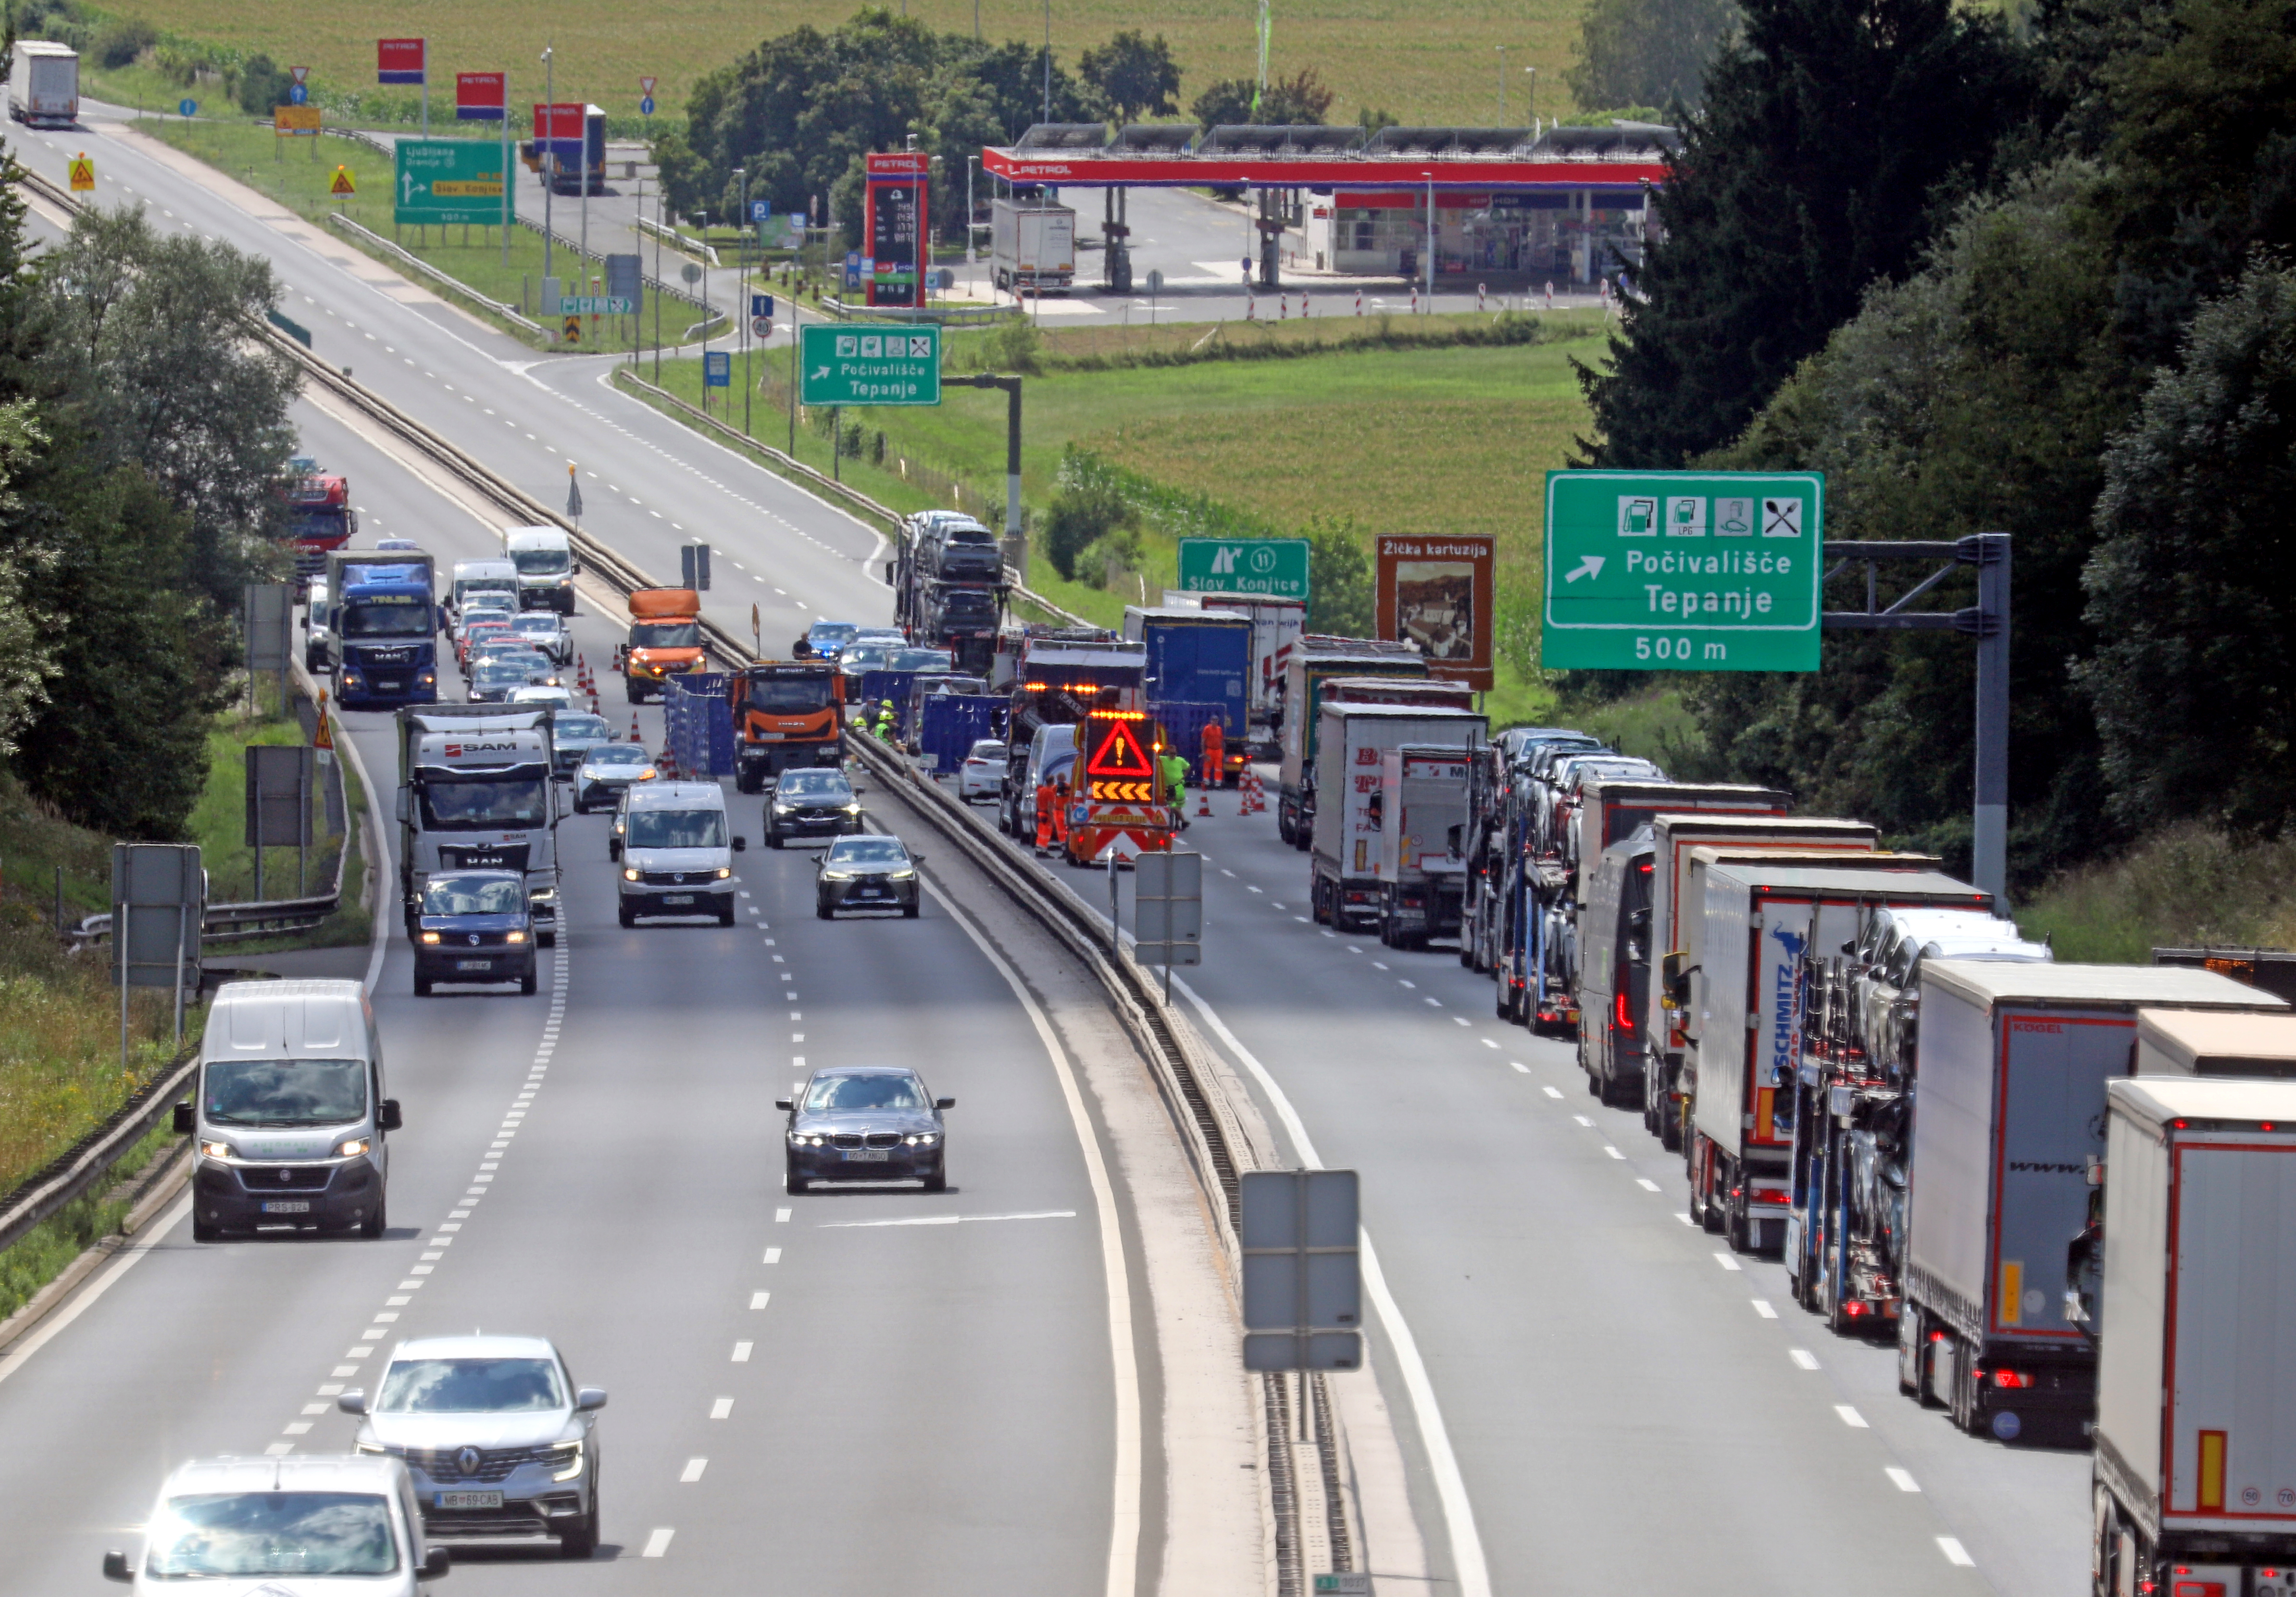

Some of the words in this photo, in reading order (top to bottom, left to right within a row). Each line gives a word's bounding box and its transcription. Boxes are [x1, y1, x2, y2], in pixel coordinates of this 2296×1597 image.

[1020, 164, 1072, 175] PETROL
[841, 363, 925, 376] Počivališče
[849, 380, 917, 399] Tepanje
[1678, 526, 1693, 536] LPG
[1383, 540, 1422, 555] Žička
[1426, 541, 1487, 558] kartuzija
[1257, 553, 1269, 567] 11
[1626, 550, 1792, 575] Počivališče
[1188, 576, 1229, 591] Slov.
[1236, 577, 1299, 594] Konjice
[1644, 584, 1773, 620] Tepanje
[1635, 637, 1692, 660] 500
[1704, 642, 1727, 660] m
[462, 742, 517, 752] SAM
[1774, 964, 1794, 1068] SCHMITZ
[445, 1495, 457, 1506] MB
[2246, 1492, 2258, 1501] 50
[2280, 1493, 2293, 1502] 70
